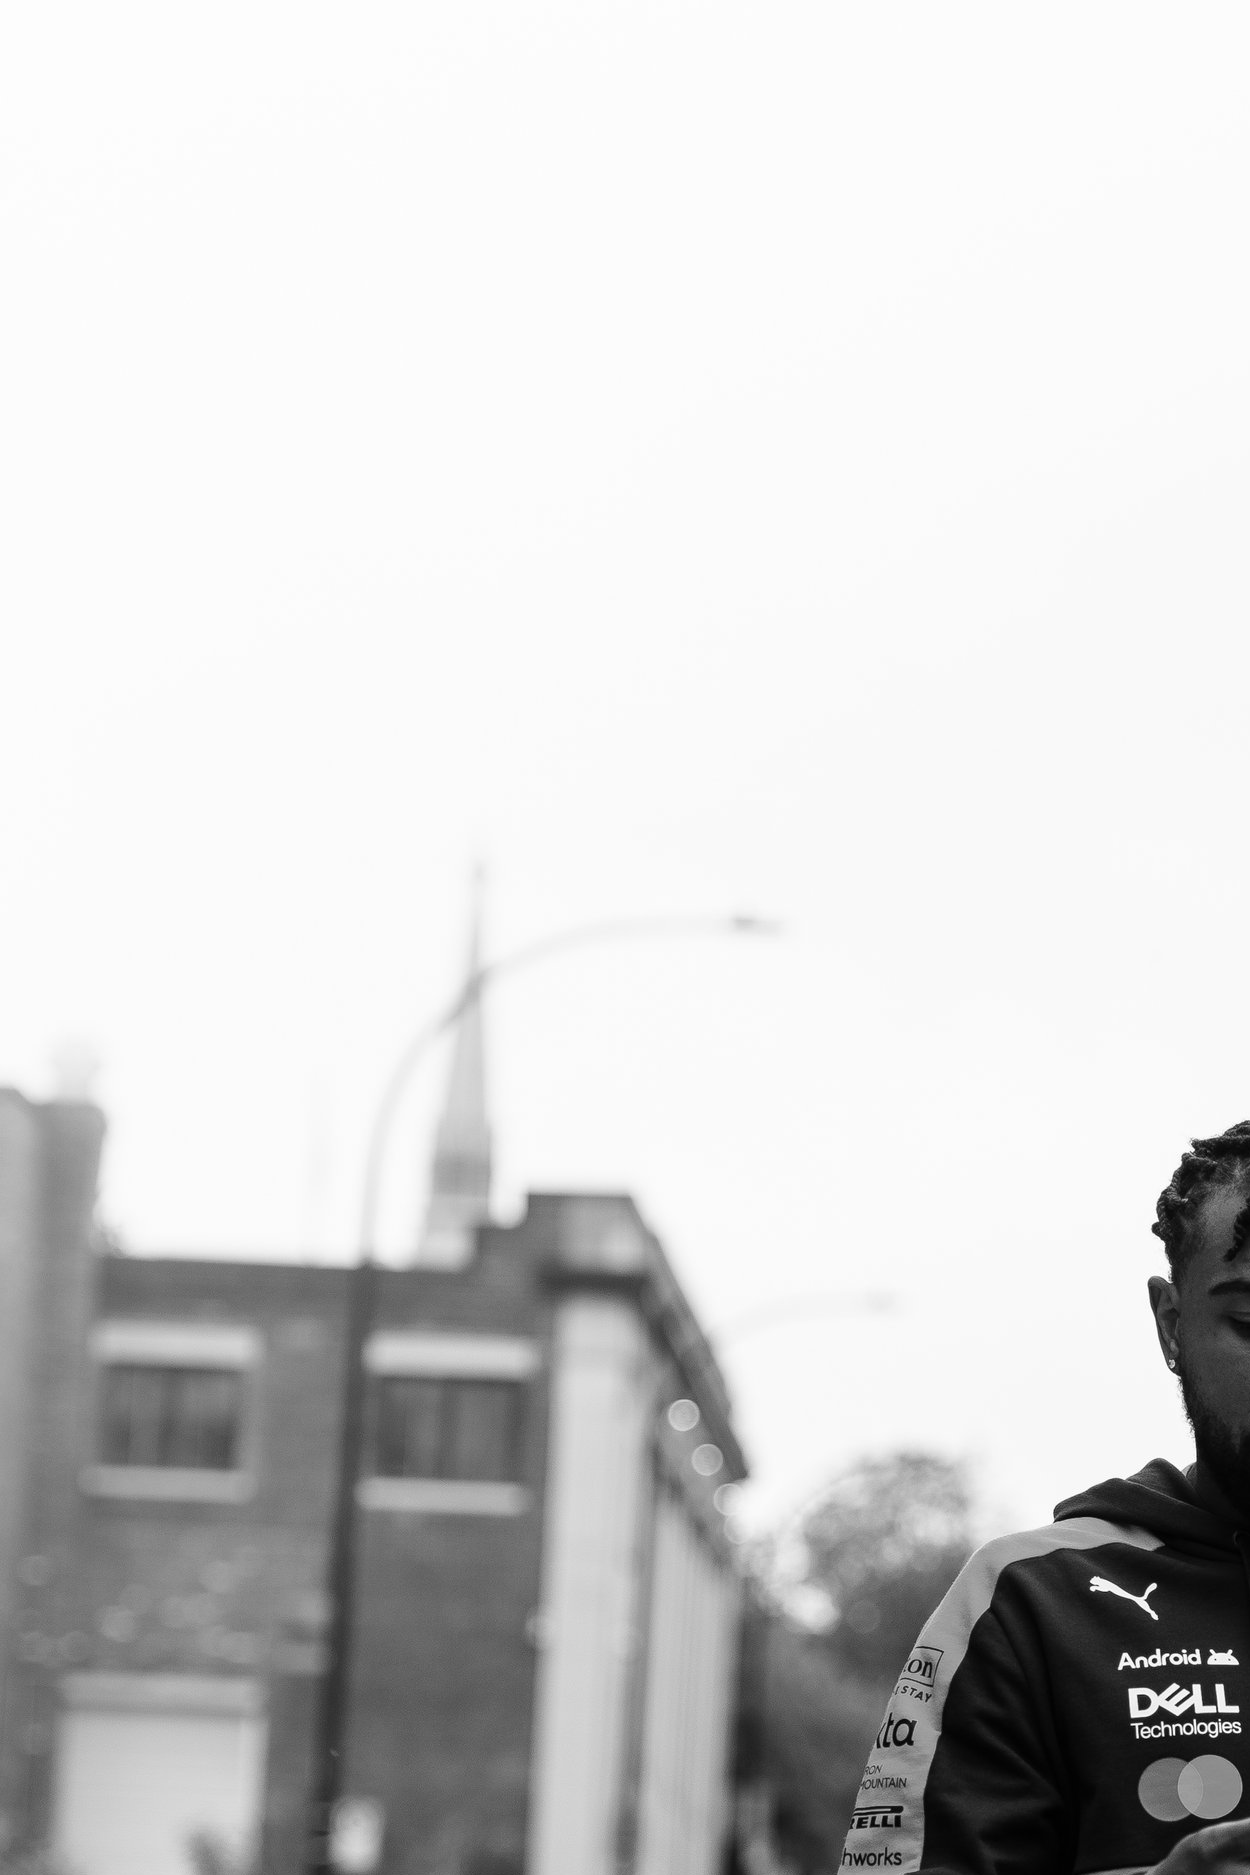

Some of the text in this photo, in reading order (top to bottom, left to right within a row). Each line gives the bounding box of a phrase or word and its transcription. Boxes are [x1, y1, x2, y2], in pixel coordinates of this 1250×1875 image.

[1117, 1648, 1202, 1671] Android
[900, 1685, 932, 1703] STAY
[1128, 1682, 1240, 1719] DELL
[1130, 1718, 1242, 1740] Technologies
